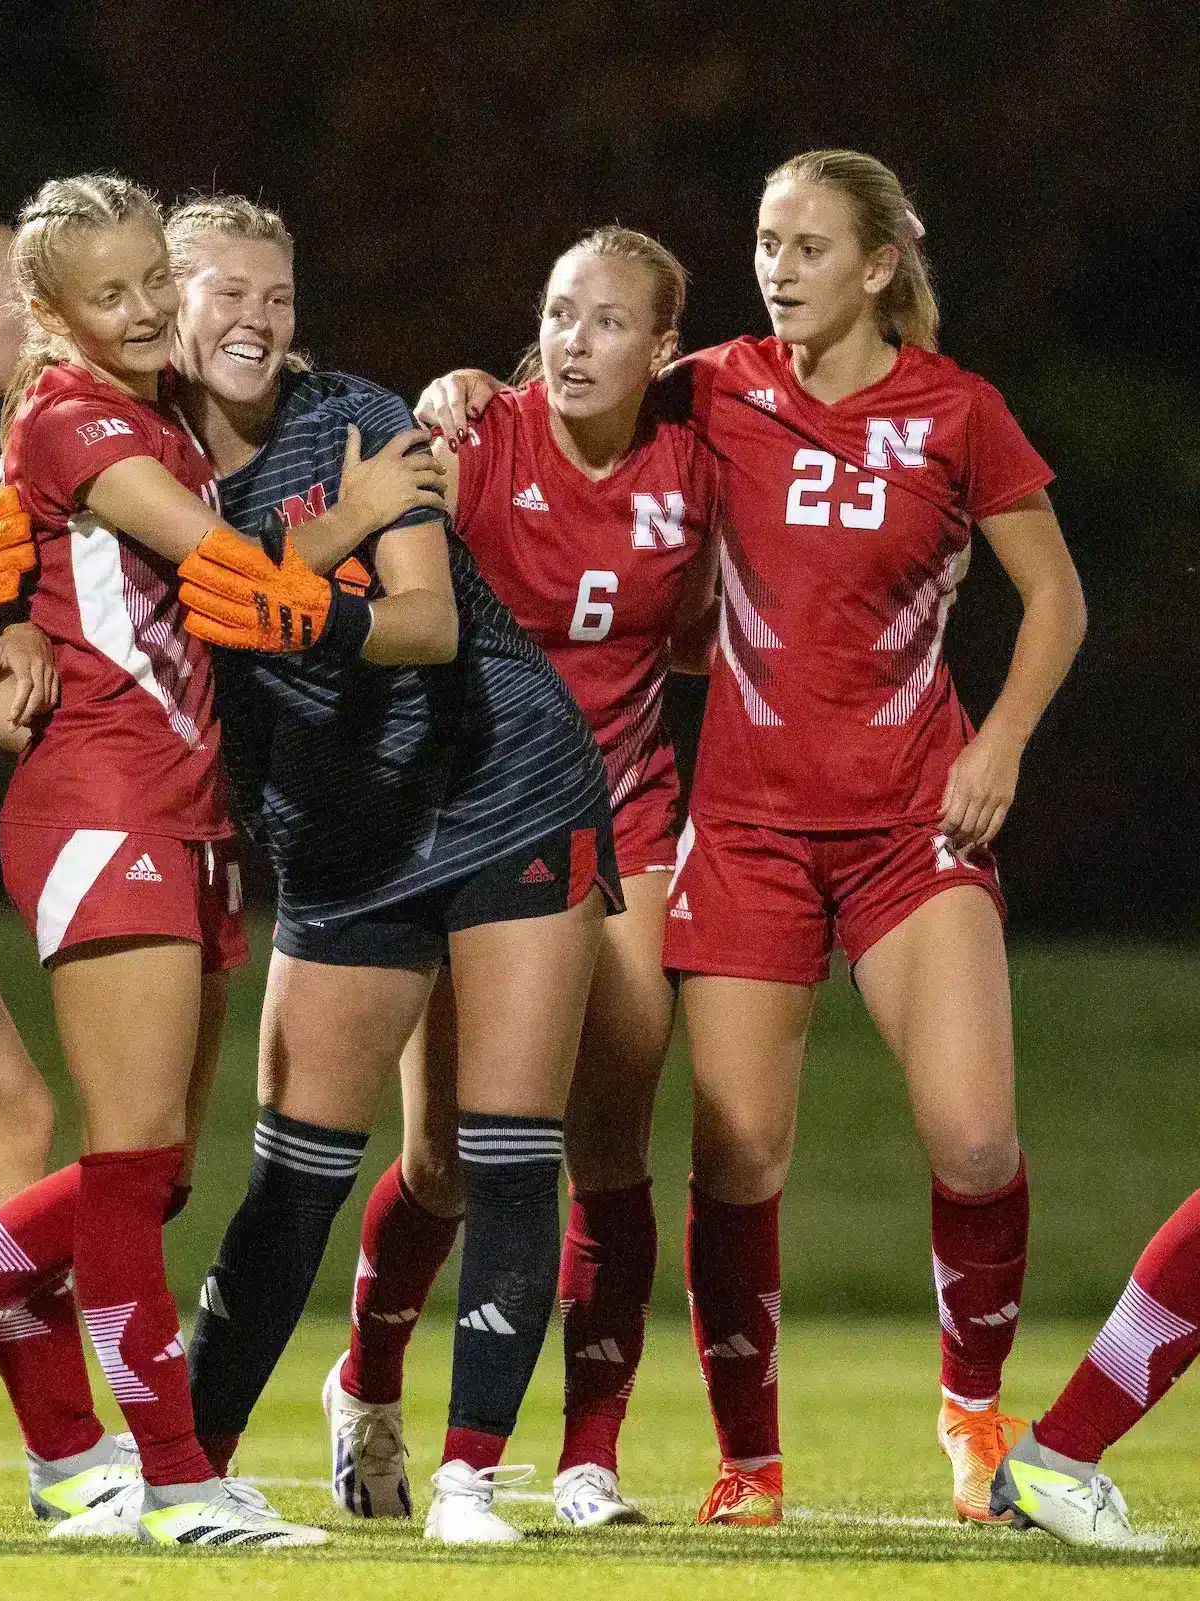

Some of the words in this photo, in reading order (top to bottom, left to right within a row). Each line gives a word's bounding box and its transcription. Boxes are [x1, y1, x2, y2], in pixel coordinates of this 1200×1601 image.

[864, 417, 933, 470] N
[512, 497, 549, 512] adidas
[785, 448, 887, 530] 23
[631, 490, 686, 549] N
[568, 570, 619, 642] 6
[125, 870, 163, 882] adidas
